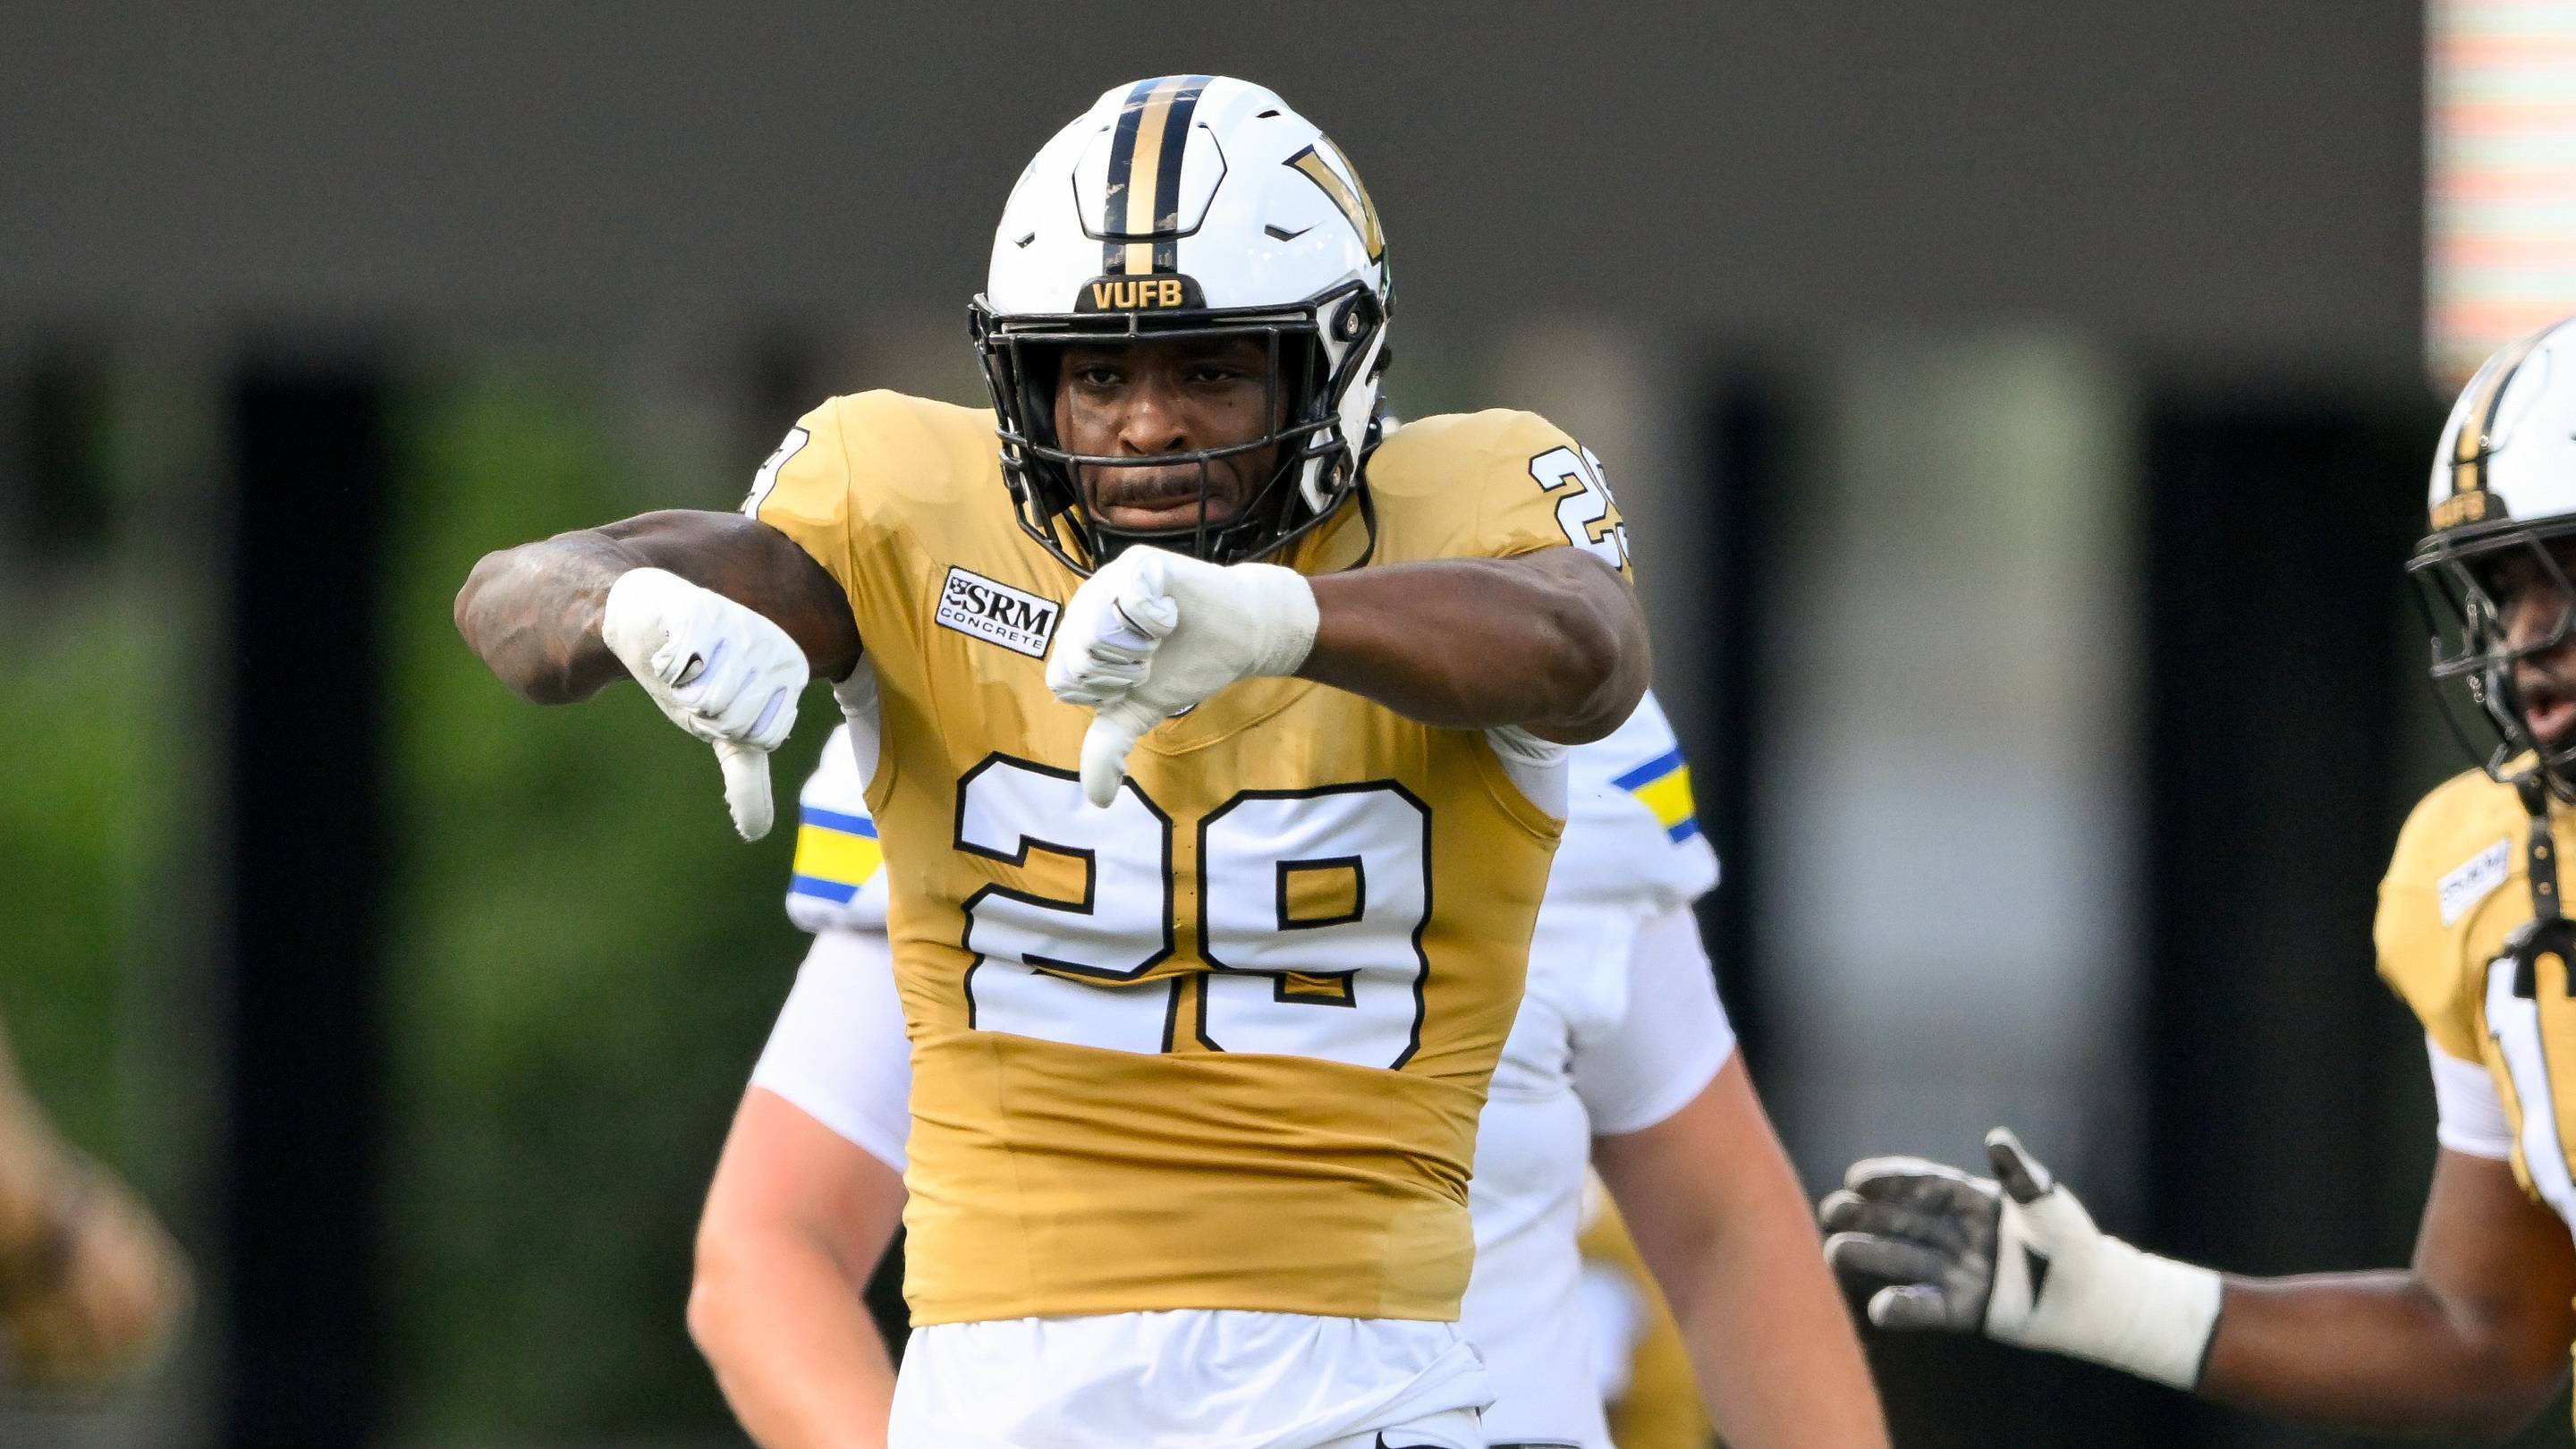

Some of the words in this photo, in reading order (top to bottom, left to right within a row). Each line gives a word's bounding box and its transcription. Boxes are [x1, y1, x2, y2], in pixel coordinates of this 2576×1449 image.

[1092, 279, 1182, 309] VUFB
[940, 606, 1044, 649] CONCRETE
[962, 584, 1053, 638] SRM
[953, 750, 1433, 1071] 29
